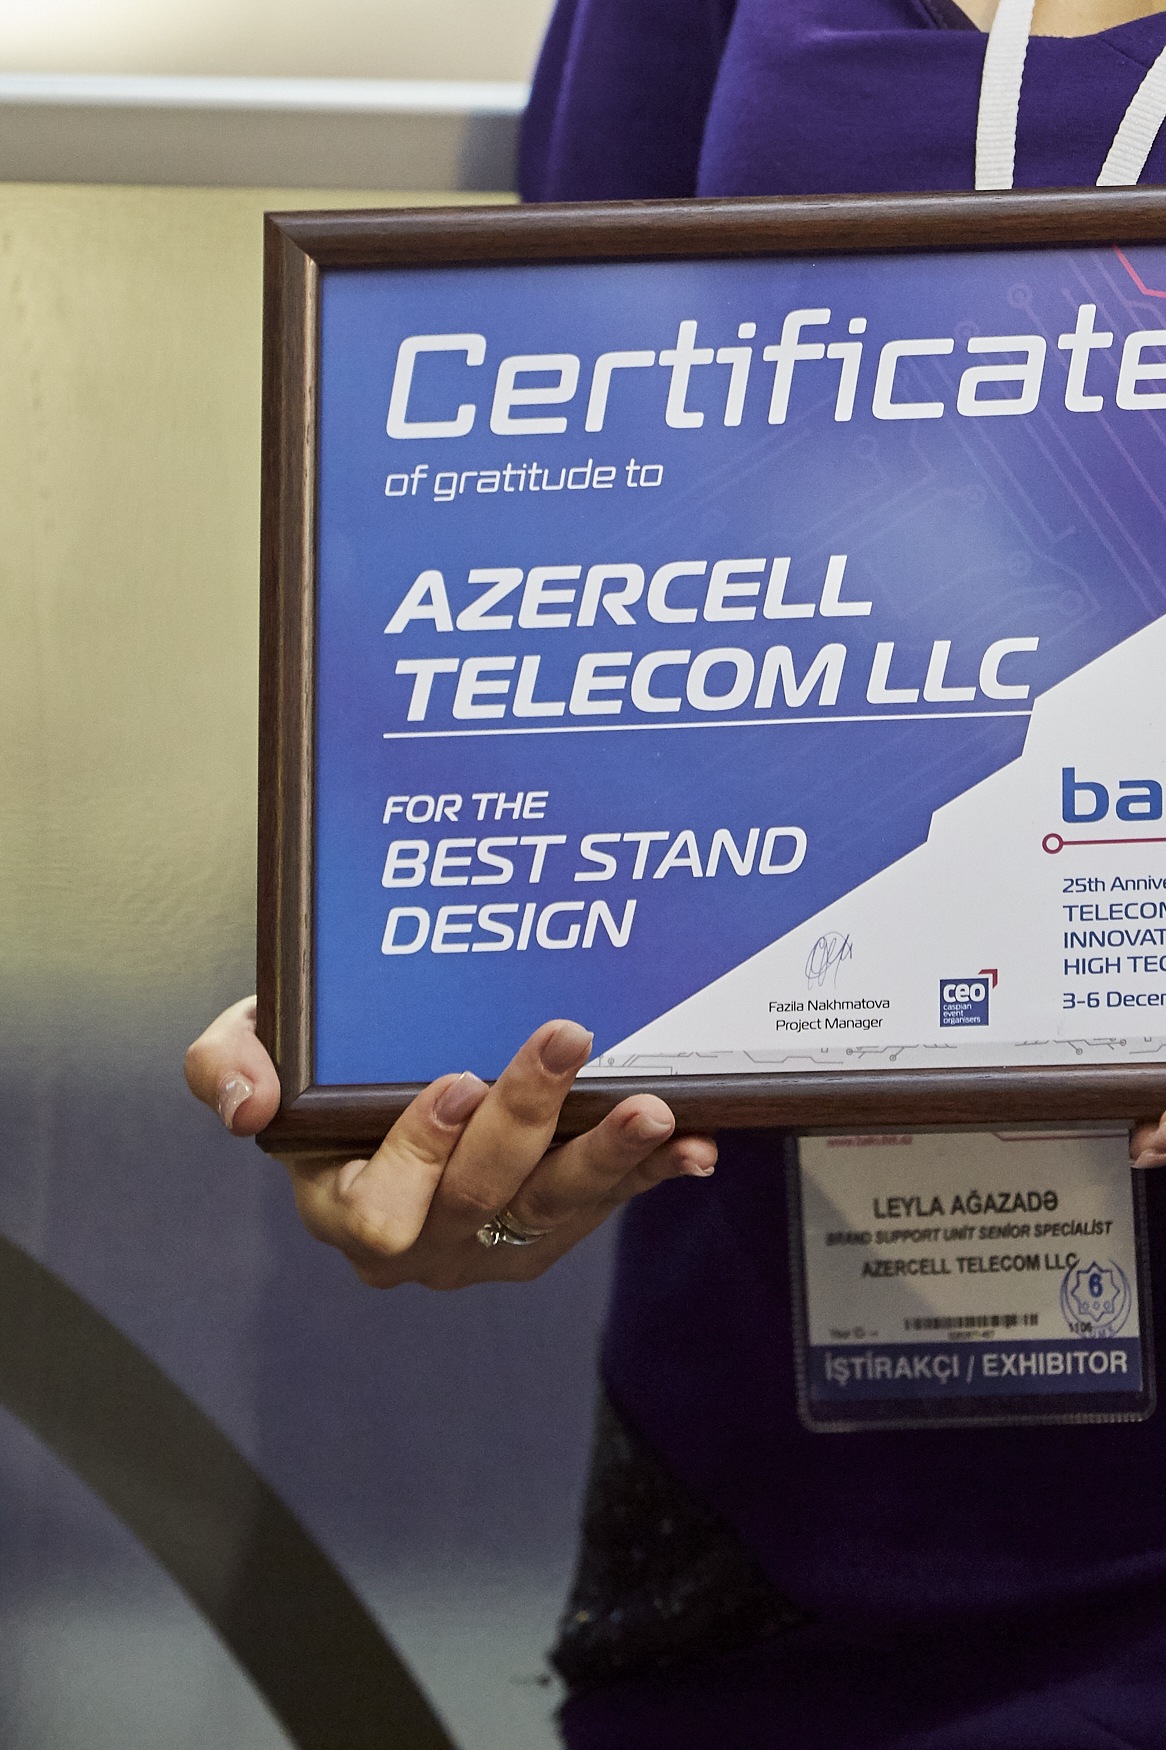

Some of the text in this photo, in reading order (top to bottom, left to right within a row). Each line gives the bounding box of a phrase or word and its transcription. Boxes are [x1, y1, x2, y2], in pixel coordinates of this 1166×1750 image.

[384, 457, 664, 502] of gratitude to
[384, 554, 874, 635] AZERCELL
[394, 636, 1040, 722] TELECOM LLC
[382, 790, 549, 825] FOR THE
[381, 825, 808, 889] BEST STAND
[1062, 877, 1106, 893] 25th
[381, 899, 637, 956] DESIGN
[1063, 955, 1122, 976] HIGH
[768, 998, 890, 1013] Fazila Nakhmatova
[942, 983, 986, 1003] ceo
[1062, 991, 1100, 1010] 3-6
[943, 1003, 972, 1011] caspian
[775, 1017, 883, 1033] Project Manager
[873, 1190, 1059, 1219] LEYLA AĞAZADƏ
[862, 1252, 1077, 1279] AZERCELL TELECOM LLC
[1088, 1272, 1103, 1298] 6
[825, 1350, 1128, 1387] İŞTİRAKÇI / EXHIBITOR
